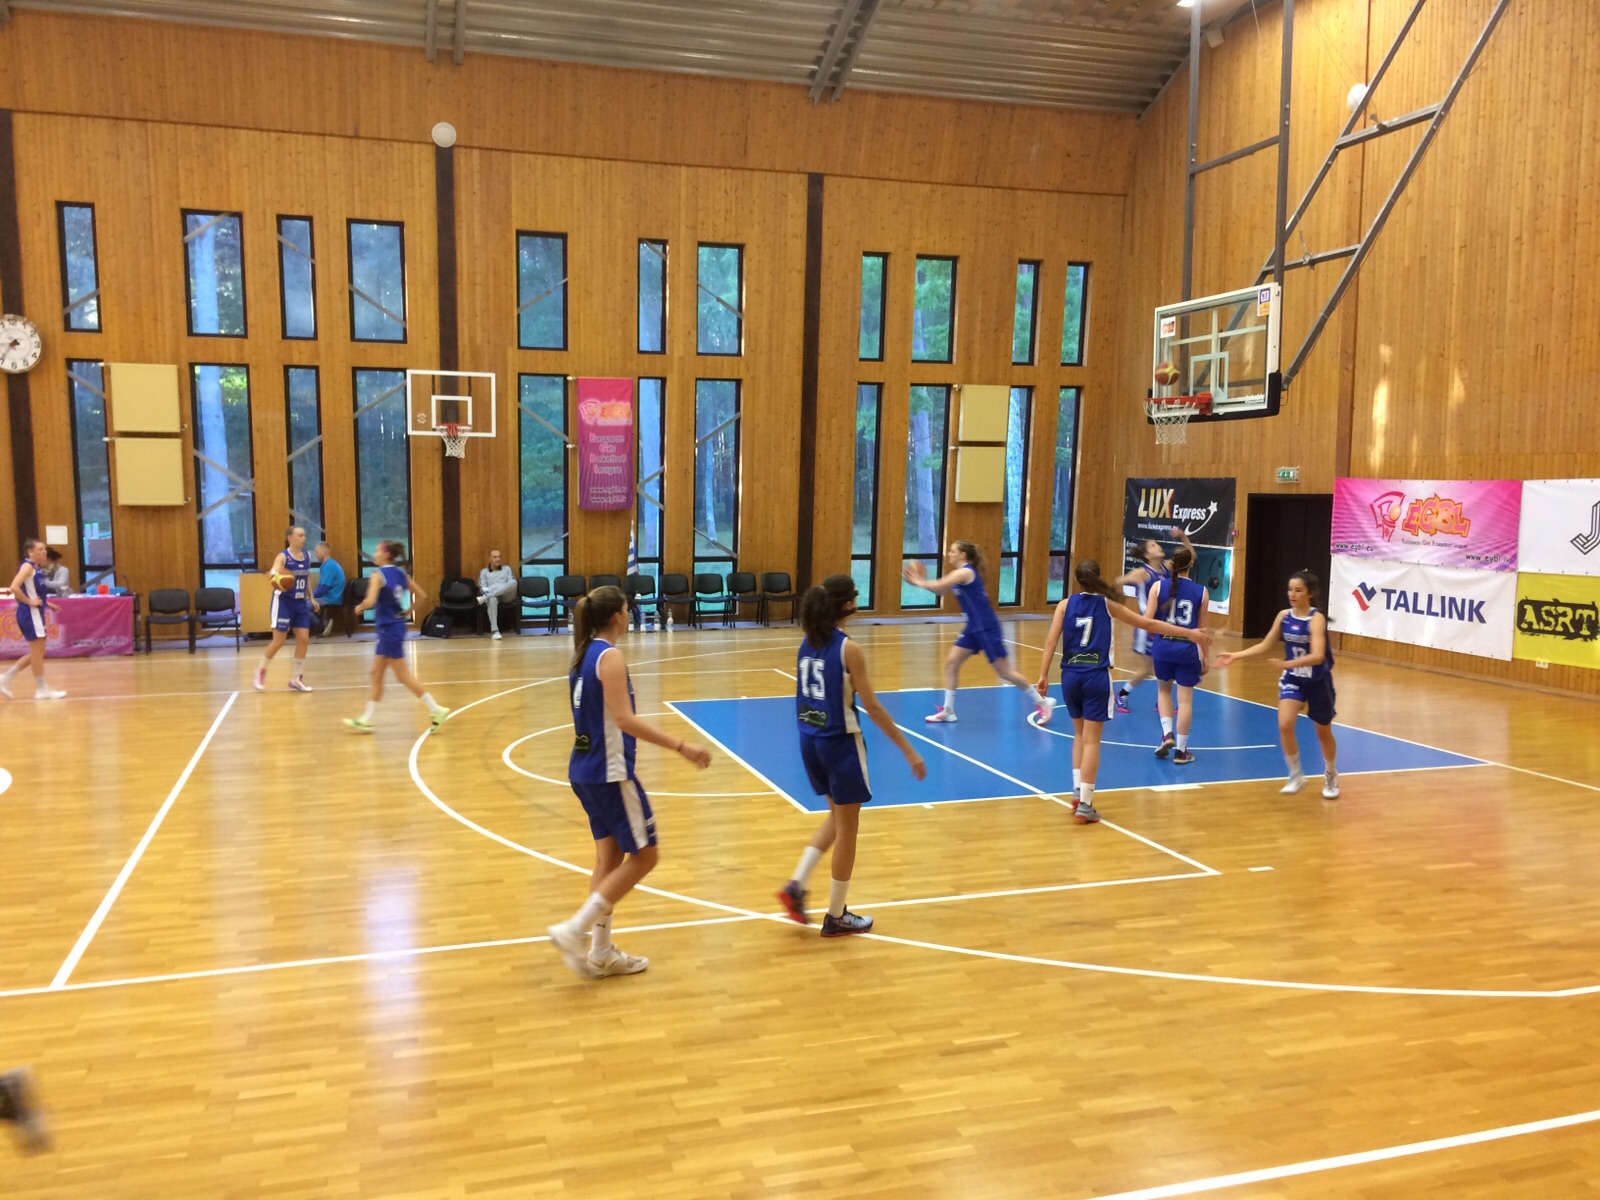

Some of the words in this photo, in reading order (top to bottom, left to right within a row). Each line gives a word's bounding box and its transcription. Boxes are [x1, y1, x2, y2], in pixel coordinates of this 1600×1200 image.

[34, 340, 40, 349] 3
[1138, 488, 1175, 518] LUX
[1173, 505, 1207, 522] Express
[1402, 493, 1471, 538] EGBL
[296, 579, 305, 590] 10
[1381, 588, 1487, 624] TALLINK
[1520, 604, 1597, 636] ASRT
[1076, 616, 1094, 648] 7
[799, 656, 826, 700] 15
